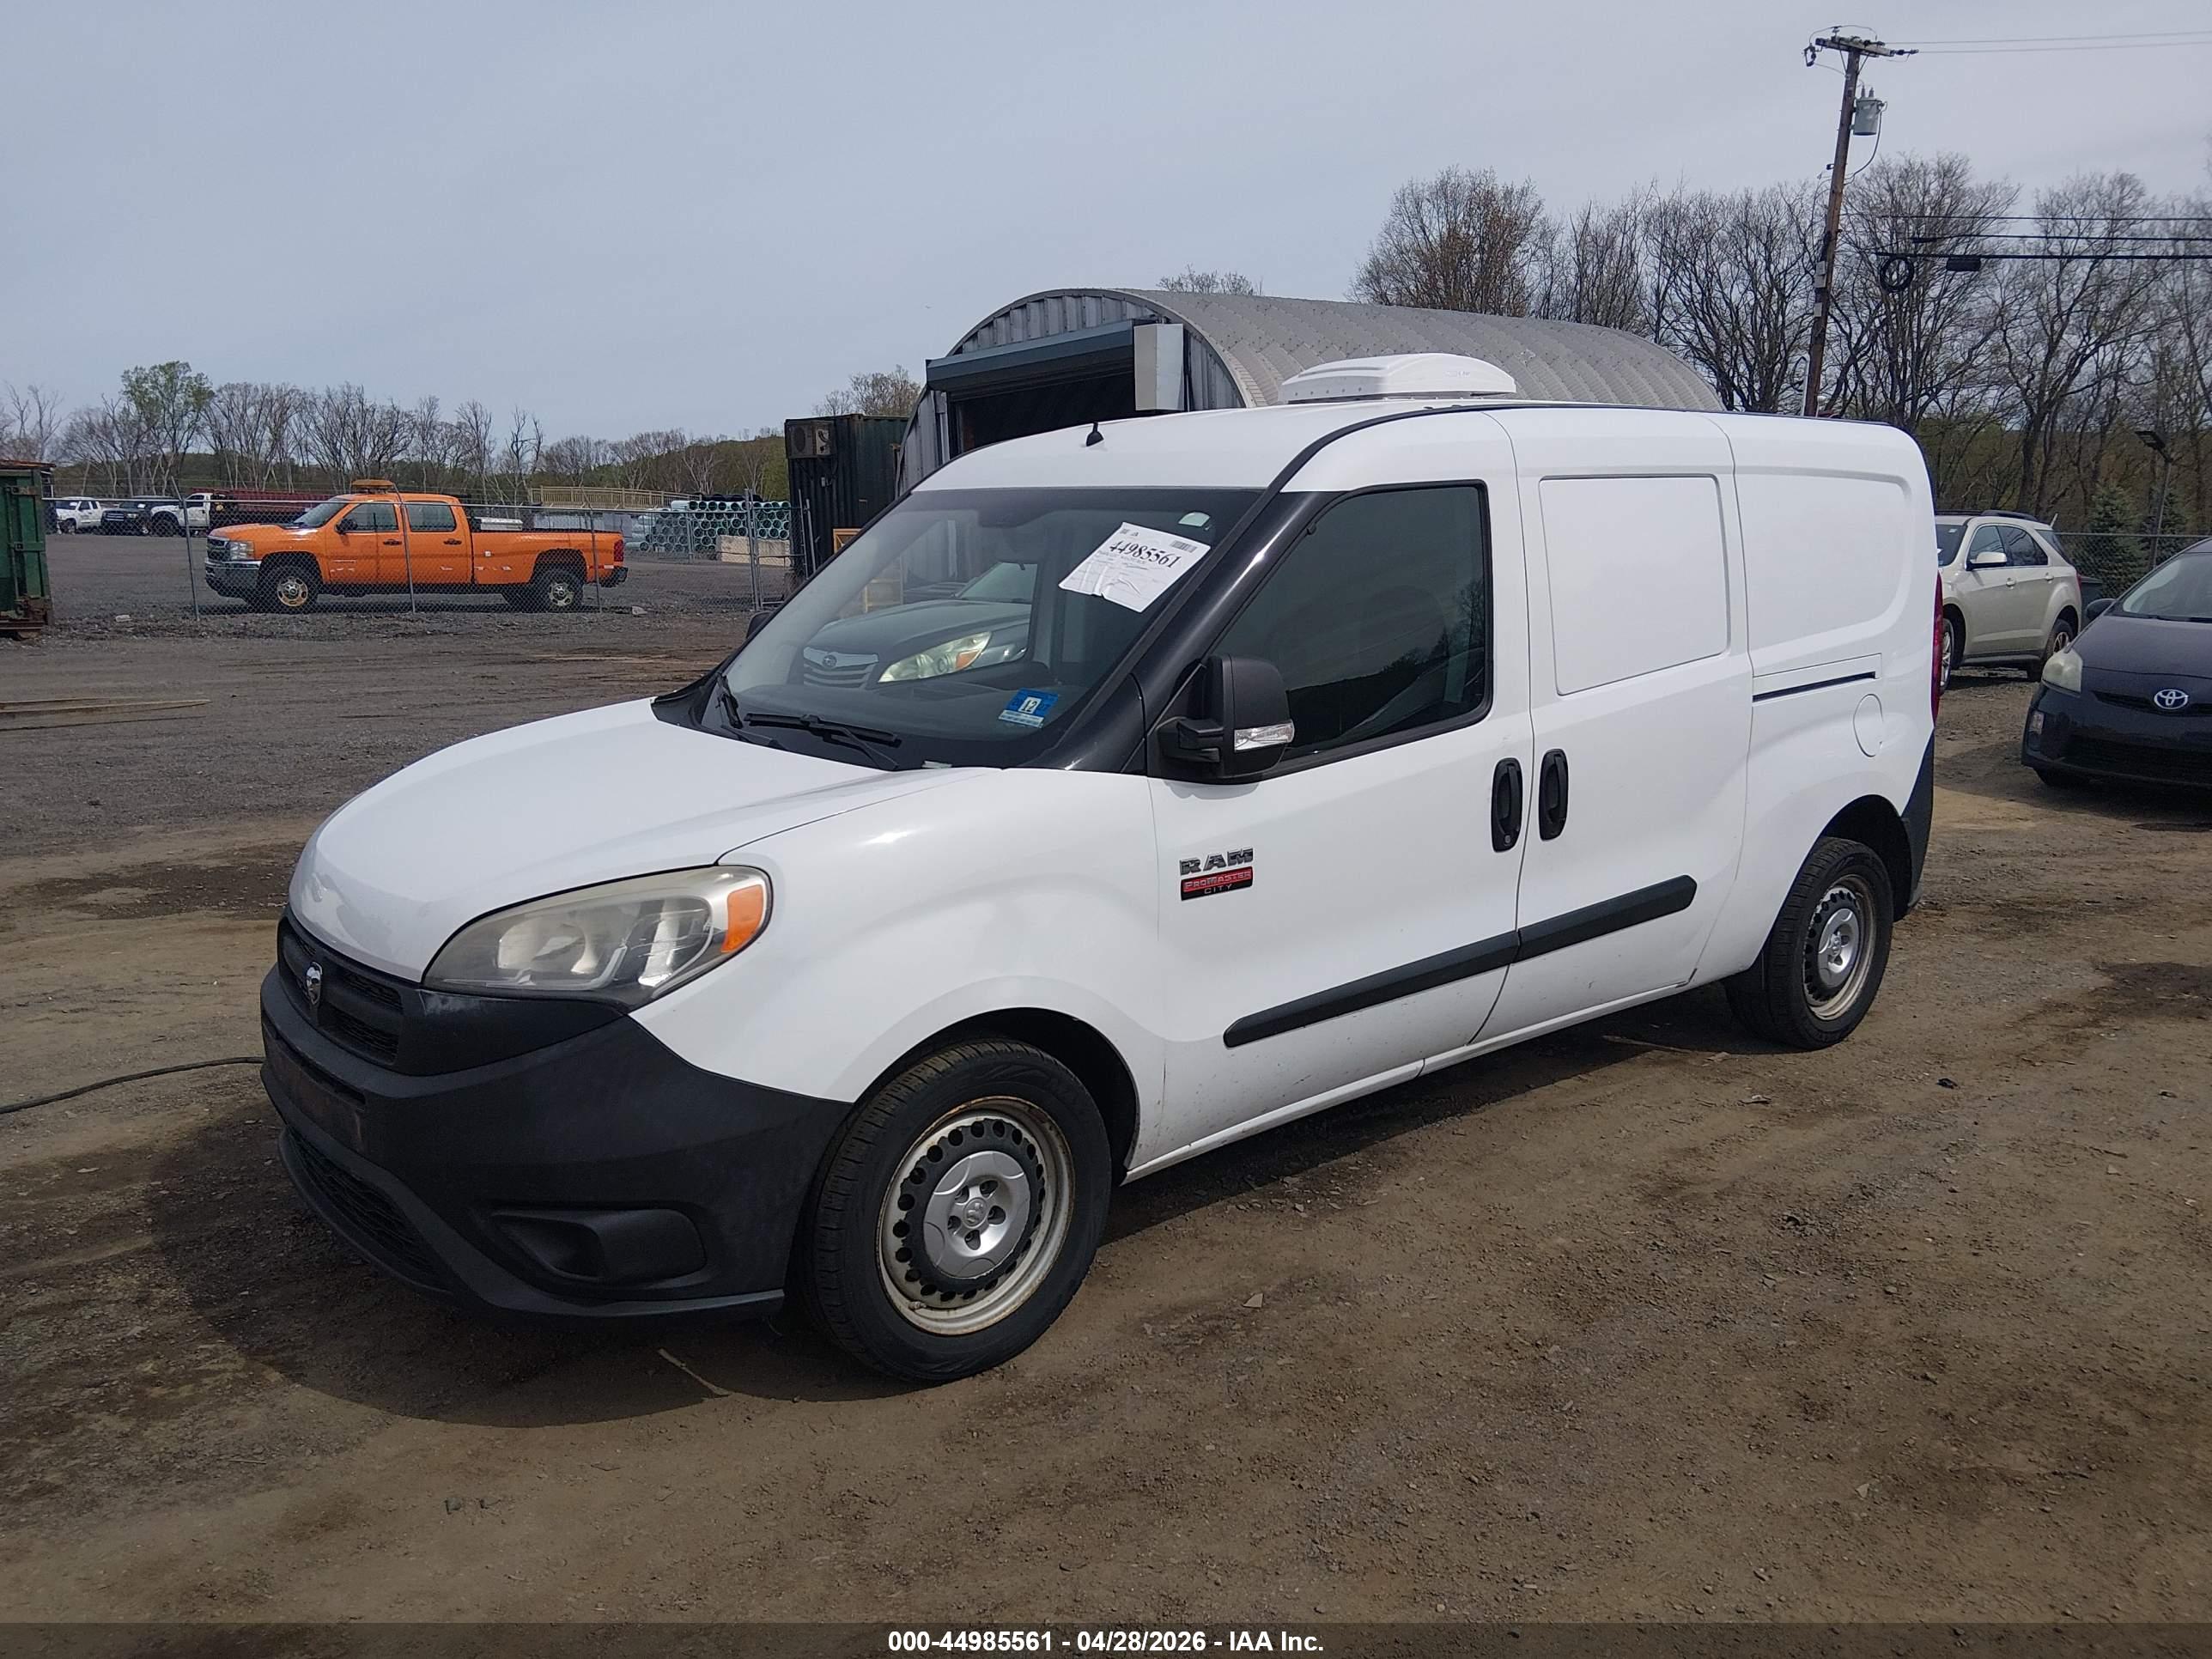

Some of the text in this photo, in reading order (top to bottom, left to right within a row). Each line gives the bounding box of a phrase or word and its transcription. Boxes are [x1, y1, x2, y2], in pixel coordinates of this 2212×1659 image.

[1109, 540, 1182, 568] 44985561
[1021, 699, 1037, 713] 12
[1179, 848, 1254, 876] RAM
[1204, 884, 1232, 895] CITY
